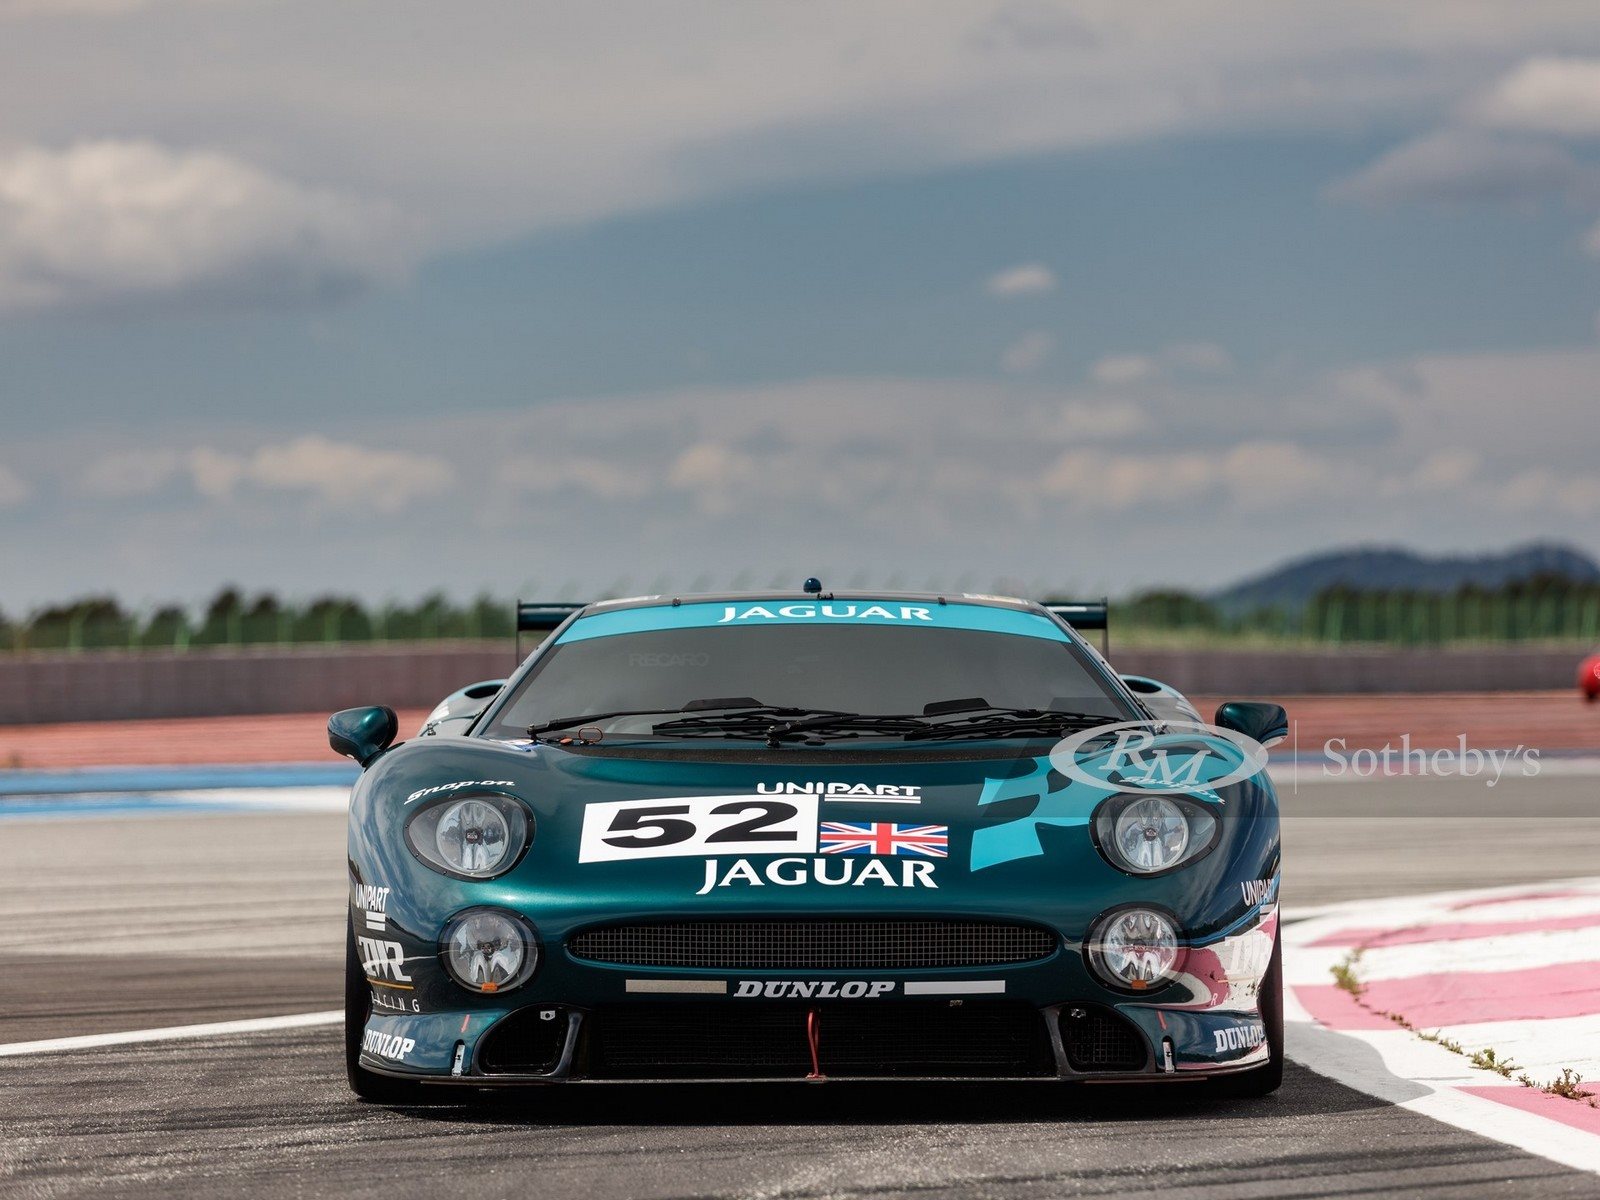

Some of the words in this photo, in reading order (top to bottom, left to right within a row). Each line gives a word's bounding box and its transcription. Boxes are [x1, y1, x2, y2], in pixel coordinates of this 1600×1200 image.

[717, 605, 933, 623] JAGUAR
[629, 652, 709, 668] RECARO
[756, 782, 921, 796] UNIPART
[600, 801, 798, 848] 52
[696, 857, 939, 894] JAGUAR
[355, 883, 390, 912] UNIPART
[733, 981, 896, 998] DUNLOP
[363, 1029, 415, 1060] DUNLOP
